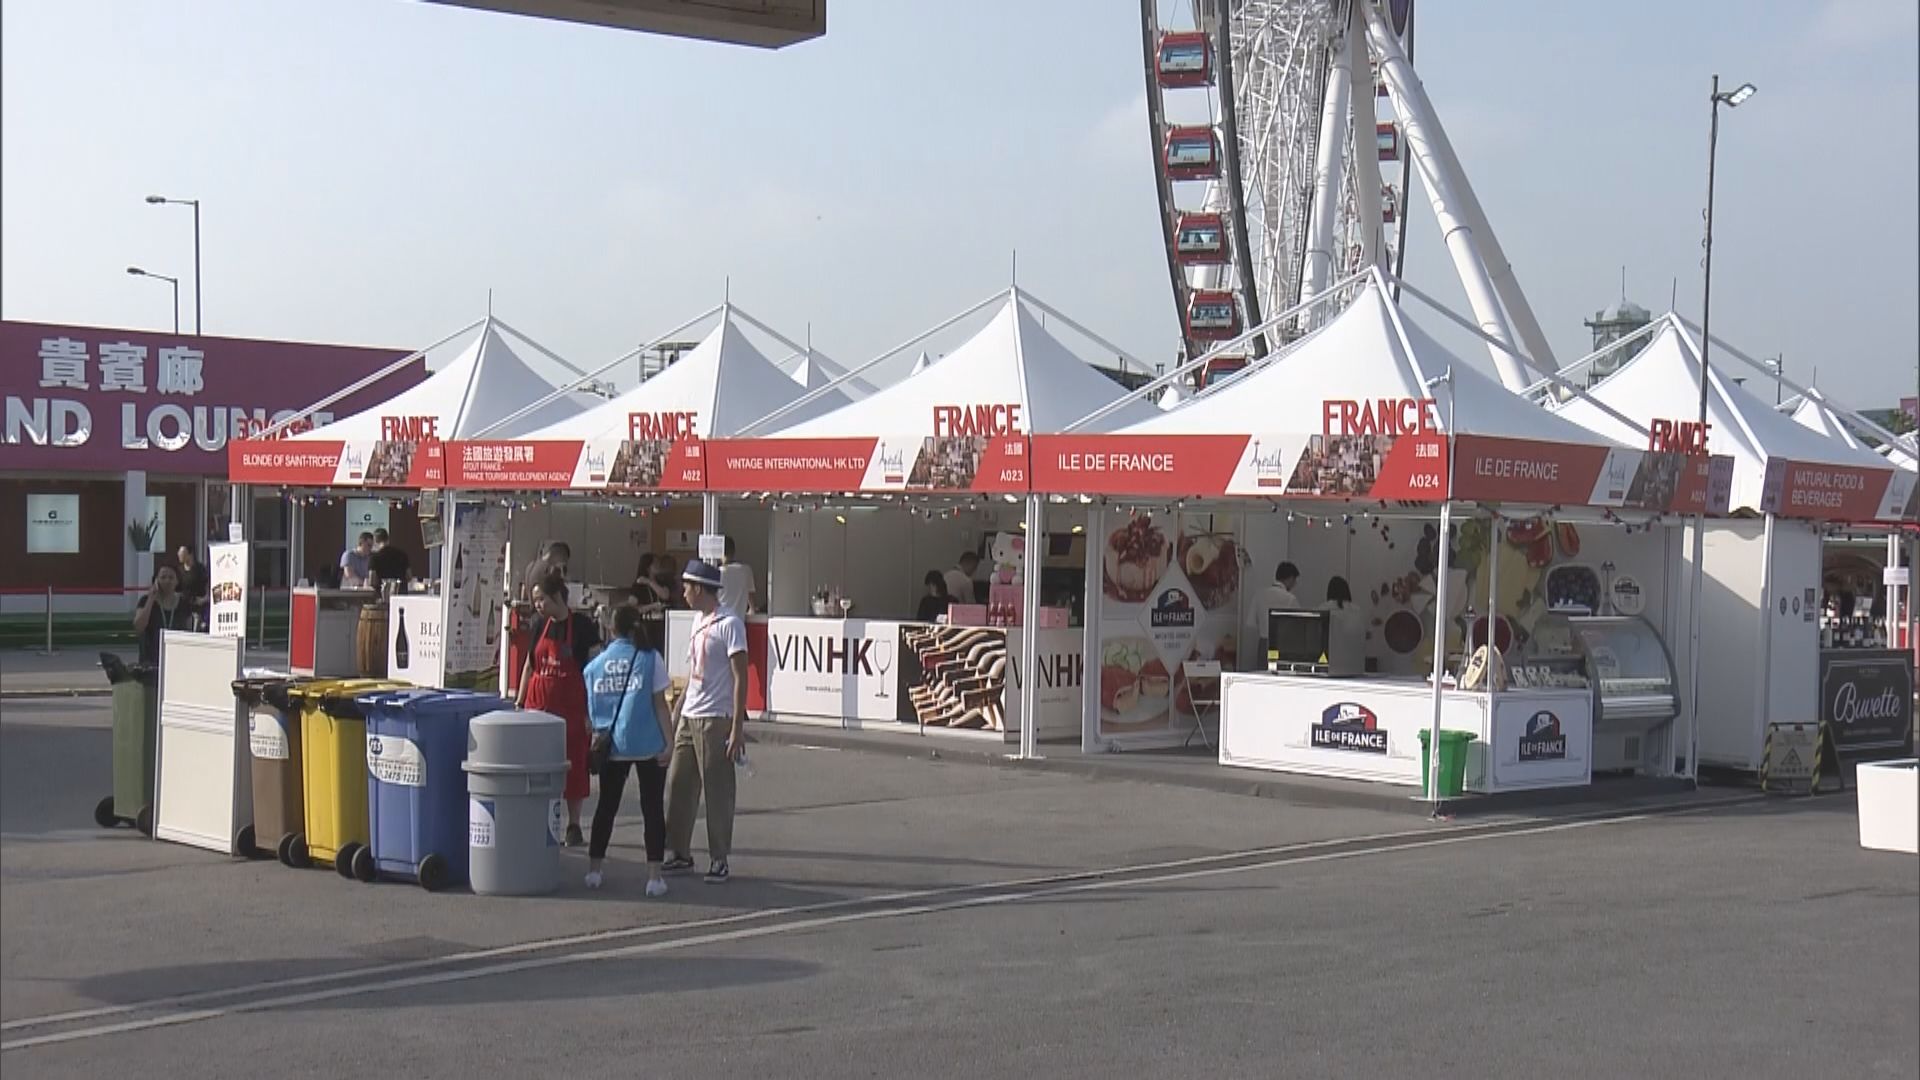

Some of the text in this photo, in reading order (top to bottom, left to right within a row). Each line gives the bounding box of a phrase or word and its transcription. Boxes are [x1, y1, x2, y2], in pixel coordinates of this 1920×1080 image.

[38, 336, 204, 396] 貴賓廊
[934, 404, 1021, 437] FRANCE
[1323, 399, 1437, 435] FRANCE
[381, 416, 440, 442] FRANCE
[629, 412, 698, 440] FRANCE
[1650, 418, 1712, 455] FRANCE
[463, 446, 534, 462] 法國旅遊發展署
[1415, 443, 1439, 458] 法國
[243, 454, 272, 466] BLONDE
[273, 455, 281, 466] OF
[284, 455, 338, 467] SAINT-TROPEZ
[463, 463, 479, 471] ATOUT
[480, 463, 501, 471] FRANCE
[727, 457, 865, 470] VINTAGE INTERNATIONAL HK LTD
[1058, 454, 1174, 471] ILE DE FRANCE
[425, 469, 440, 480] A021
[463, 472, 571, 482] FRANCE TOURISM DEVELOPMENT AGENCY
[682, 470, 701, 481] A022
[1000, 469, 1023, 482] A023
[1475, 458, 1559, 480] ILE DE FRANCE
[1408, 473, 1439, 488] A024
[1794, 470, 1831, 488] NATURAL
[1833, 474, 1858, 489] FOOD
[1858, 475, 1865, 489] &
[1791, 490, 1843, 508] BEVERAGES
[773, 634, 873, 676] VINHK
[605, 660, 630, 673] GO
[593, 676, 643, 692] GREEN
[1834, 682, 1900, 723] Buvette
[1315, 729, 1330, 743] ILE
[1331, 731, 1340, 741] DE
